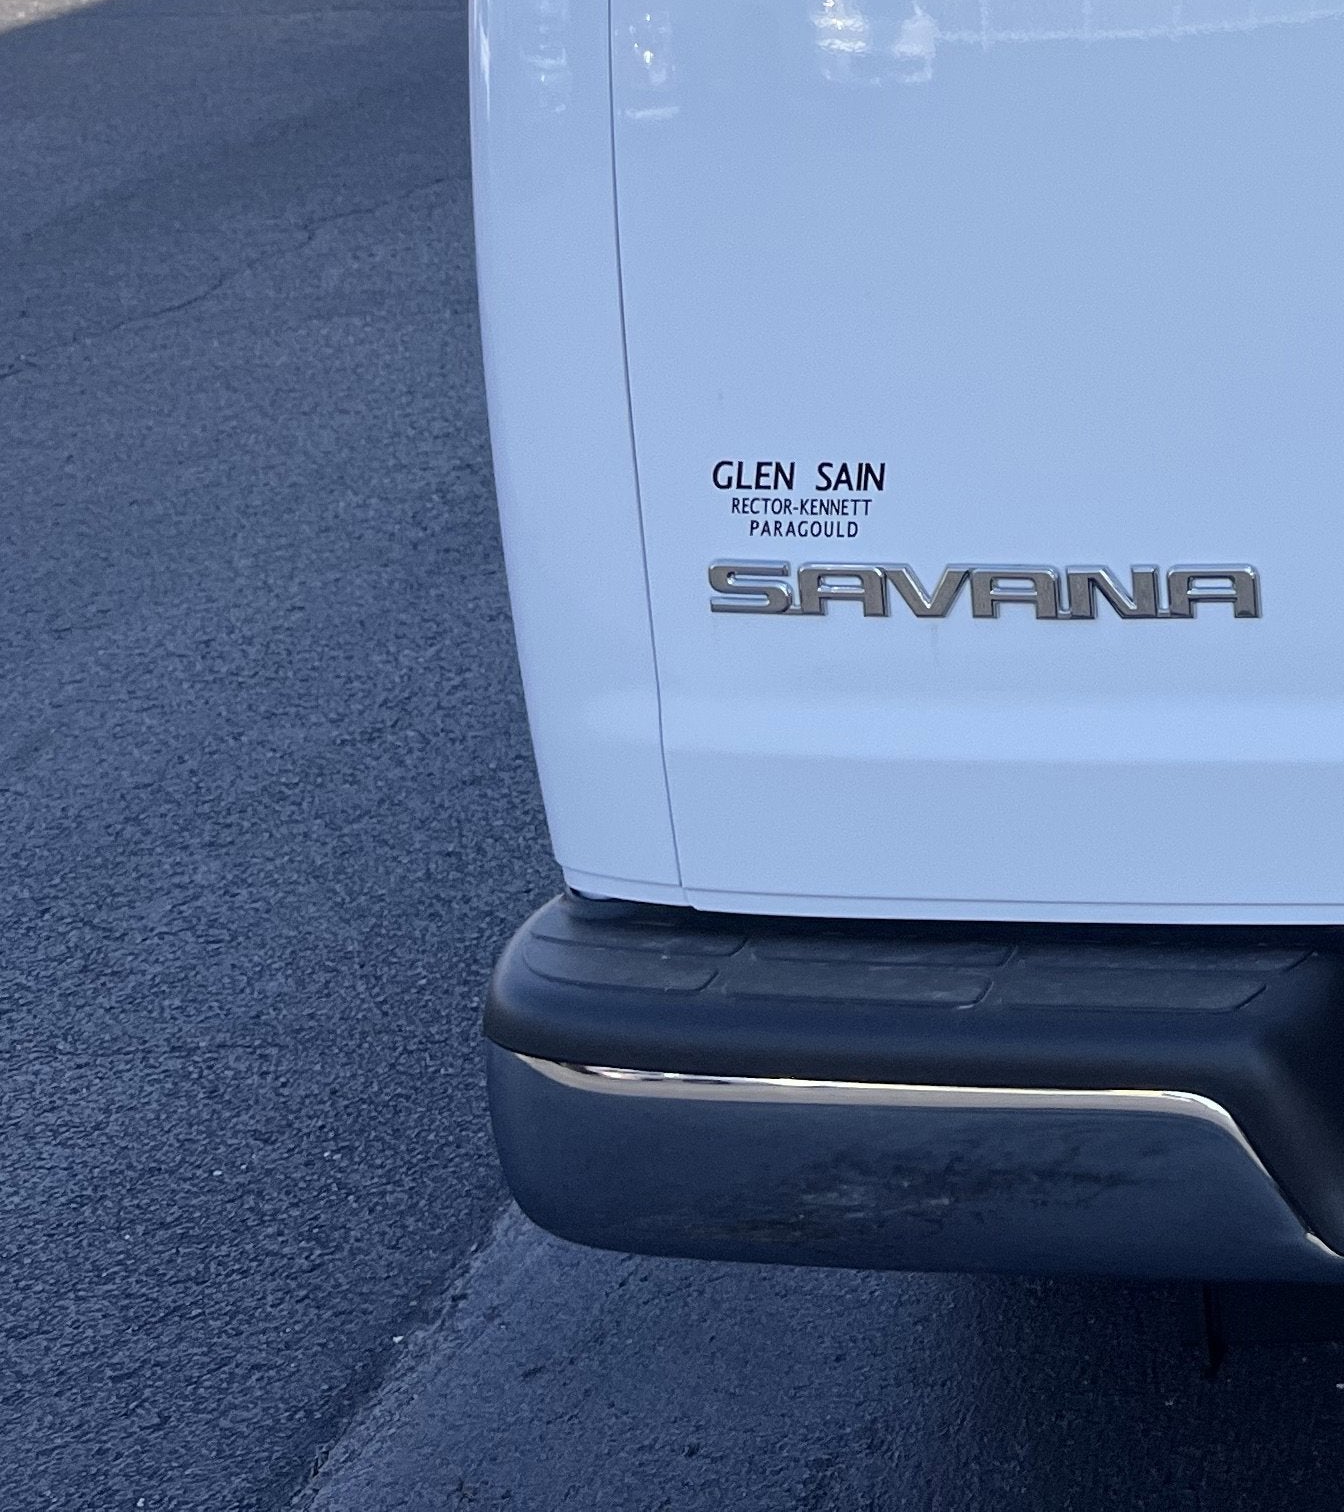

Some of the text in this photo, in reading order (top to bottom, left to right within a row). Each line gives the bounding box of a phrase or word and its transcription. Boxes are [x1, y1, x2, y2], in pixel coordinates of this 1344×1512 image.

[712, 460, 886, 491] GLEN SAIN
[731, 497, 872, 516] RECTOR-KENNETT
[750, 519, 859, 538] PARAGOULD
[708, 558, 1262, 619] SAVANA
